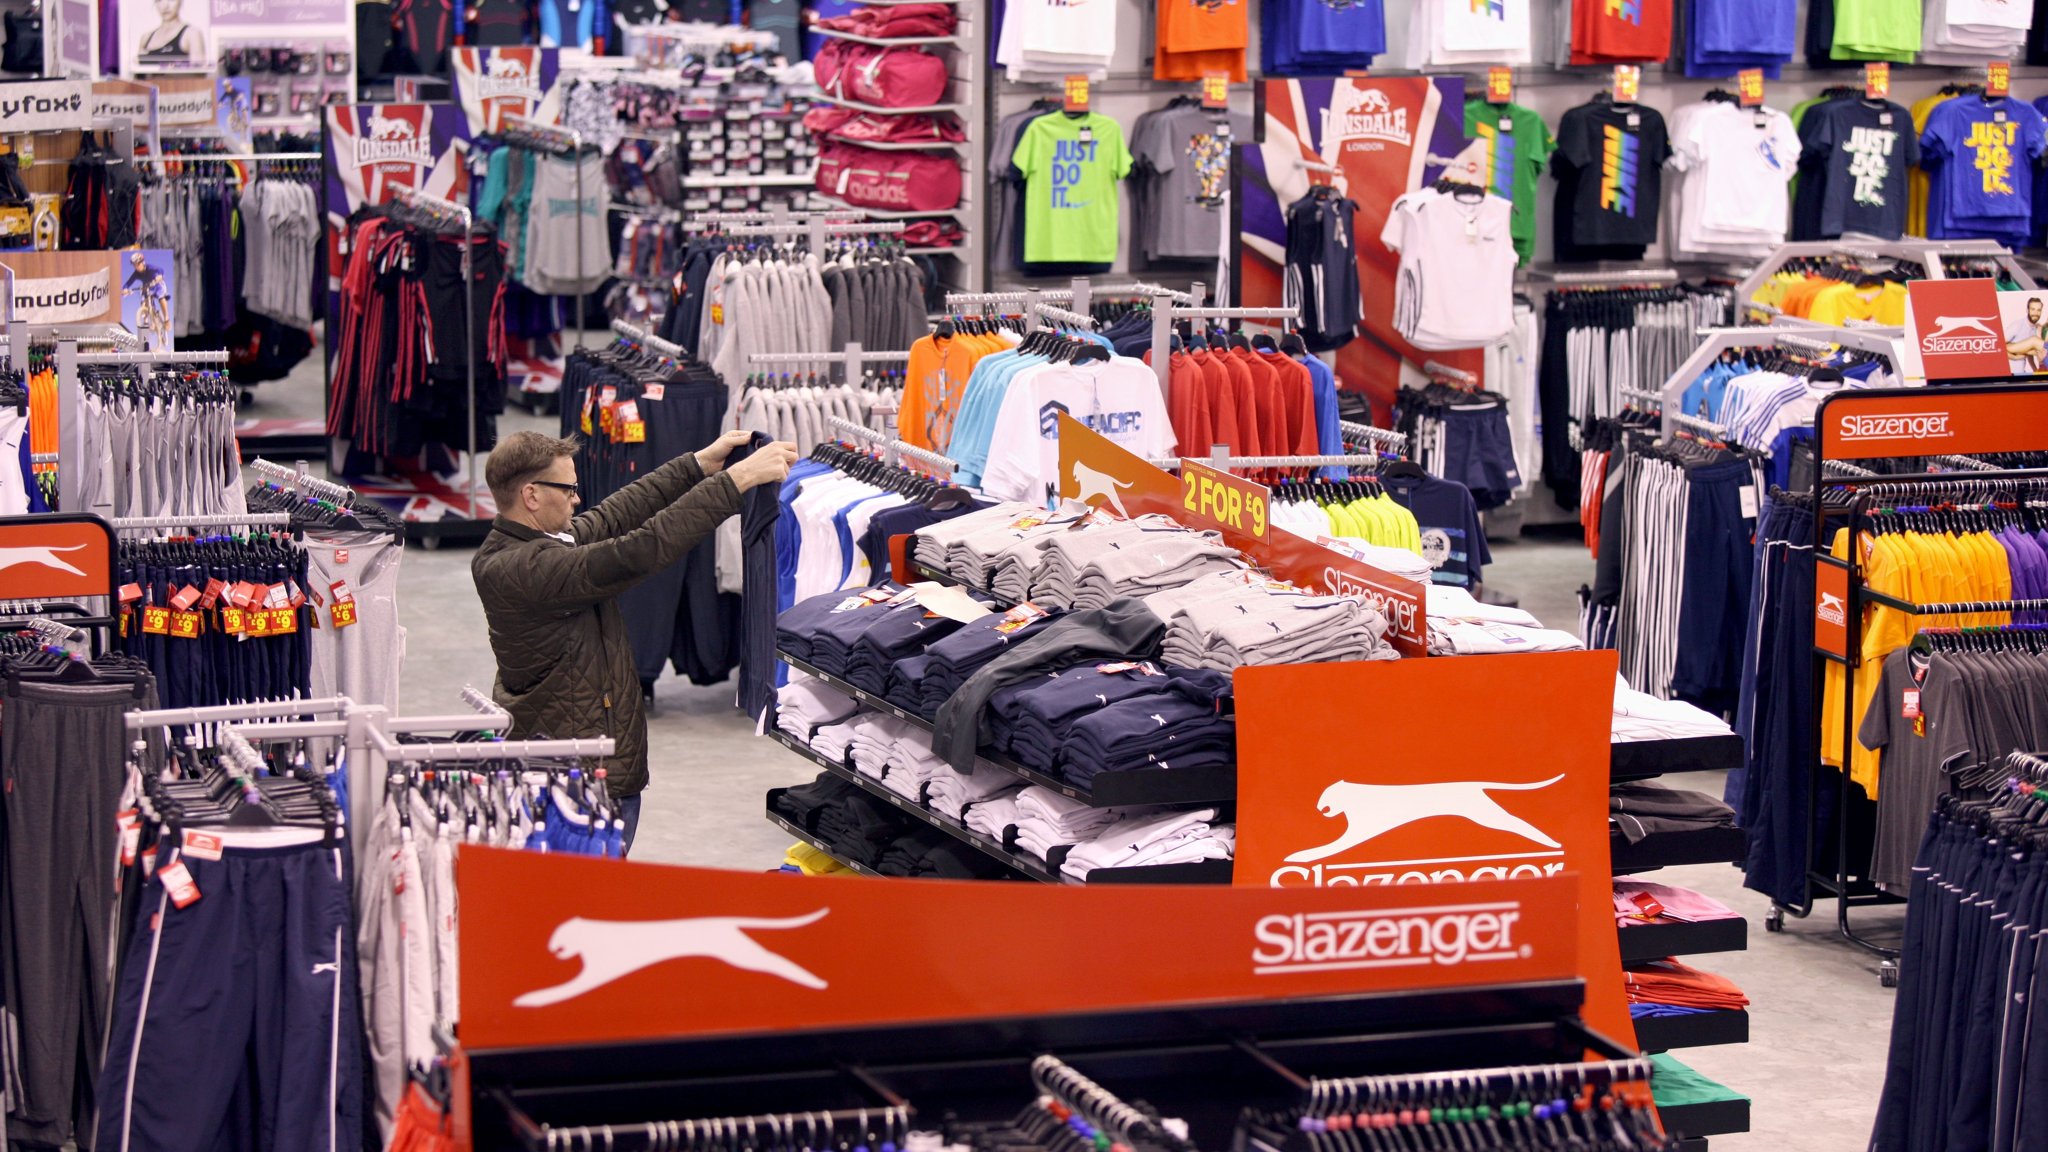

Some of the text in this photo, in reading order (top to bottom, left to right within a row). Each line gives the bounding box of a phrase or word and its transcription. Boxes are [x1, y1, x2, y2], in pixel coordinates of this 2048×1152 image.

[1319, 107, 1411, 147] LONSDALE
[1963, 121, 2021, 147] JUST
[1346, 142, 1385, 152] LONDON
[1842, 126, 1898, 156] JUST
[352, 135, 434, 169] LONSDALE
[1053, 140, 1099, 162] JUST
[1053, 163, 1081, 184] DO
[15, 286, 107, 308] muddyfox
[1921, 337, 1998, 354] Slazenger
[1840, 415, 1949, 439] Slazenger
[1184, 471, 1265, 537] 2 FOR £9
[153, 609, 169, 617] FOR
[336, 610, 350, 620] £6
[339, 603, 354, 611] FOR
[149, 616, 164, 628] £9
[178, 620, 193, 632] £9
[182, 613, 198, 621] FOR
[251, 618, 266, 630] £9
[276, 616, 290, 628] £9
[1252, 912, 1520, 965] Slazenger
